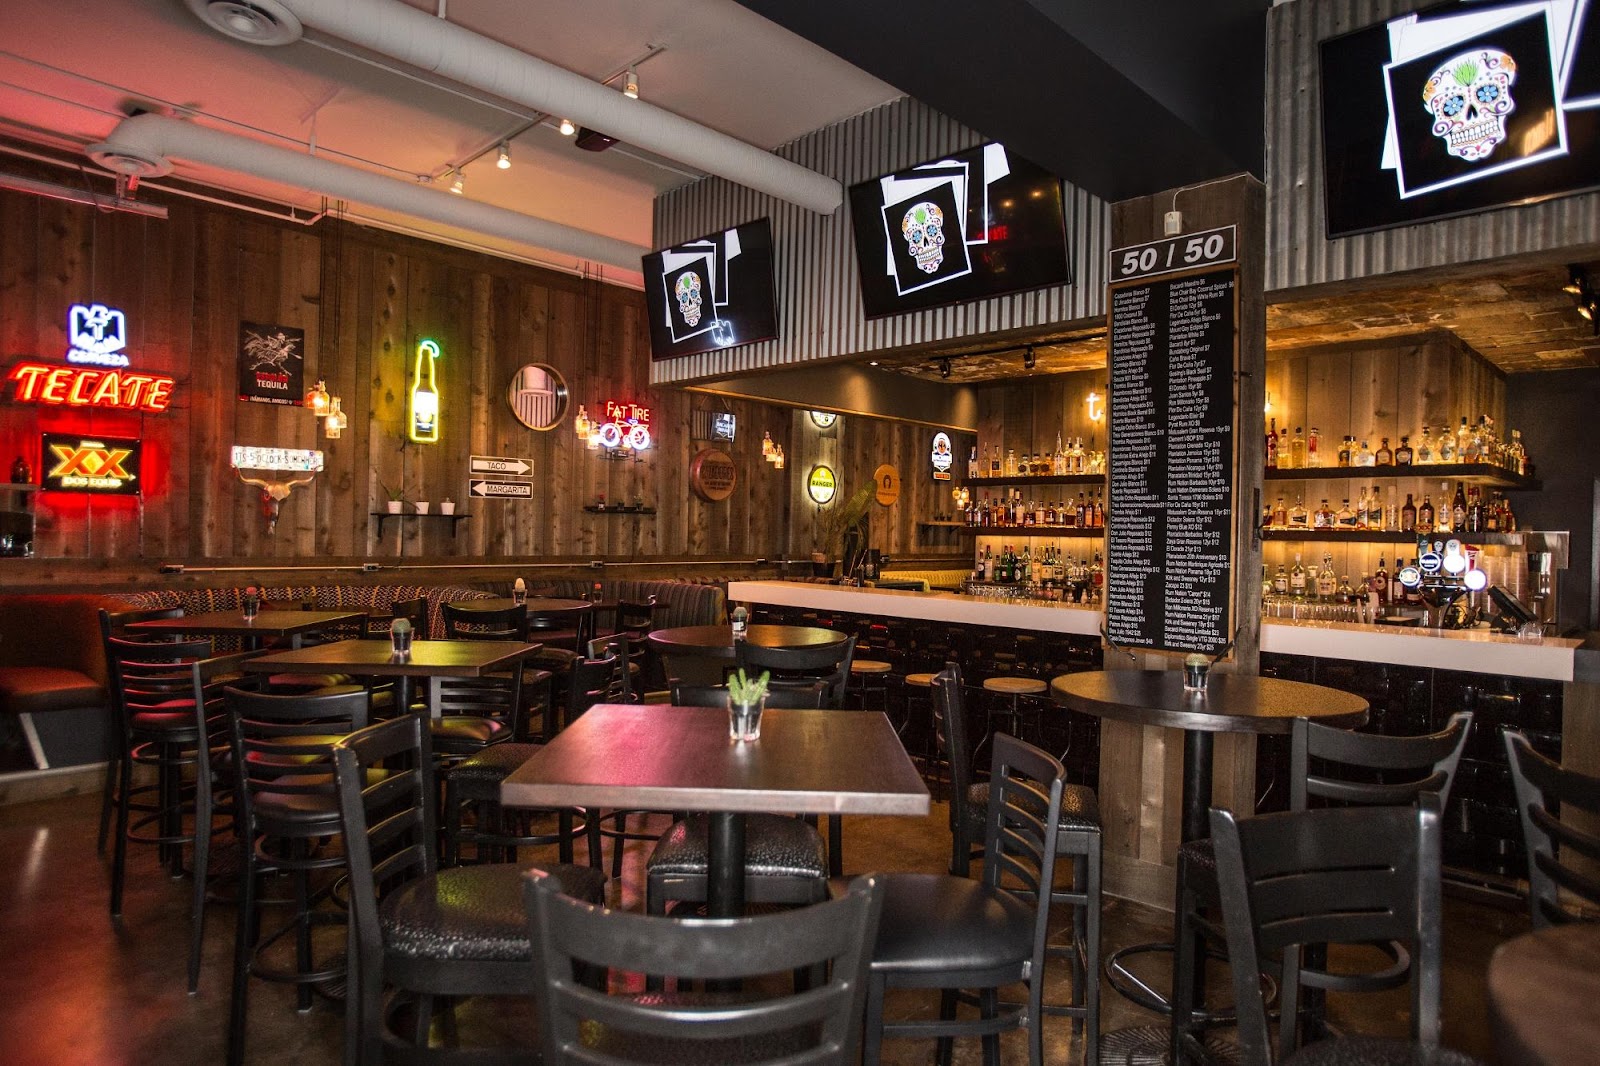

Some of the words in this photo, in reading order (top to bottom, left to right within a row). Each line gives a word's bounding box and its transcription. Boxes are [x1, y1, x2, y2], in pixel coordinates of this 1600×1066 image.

[1121, 248, 1158, 275] 50
[1166, 244, 1175, 267] /
[1184, 234, 1224, 263] 50
[11, 363, 174, 411] TECATE
[257, 380, 288, 390] TEQUILA
[607, 402, 627, 419] FAT
[629, 404, 649, 422] TIRE
[487, 461, 506, 470] TACO
[62, 476, 88, 488] DOS
[88, 477, 122, 489] EQUIS
[487, 485, 528, 495] MARGARITA
